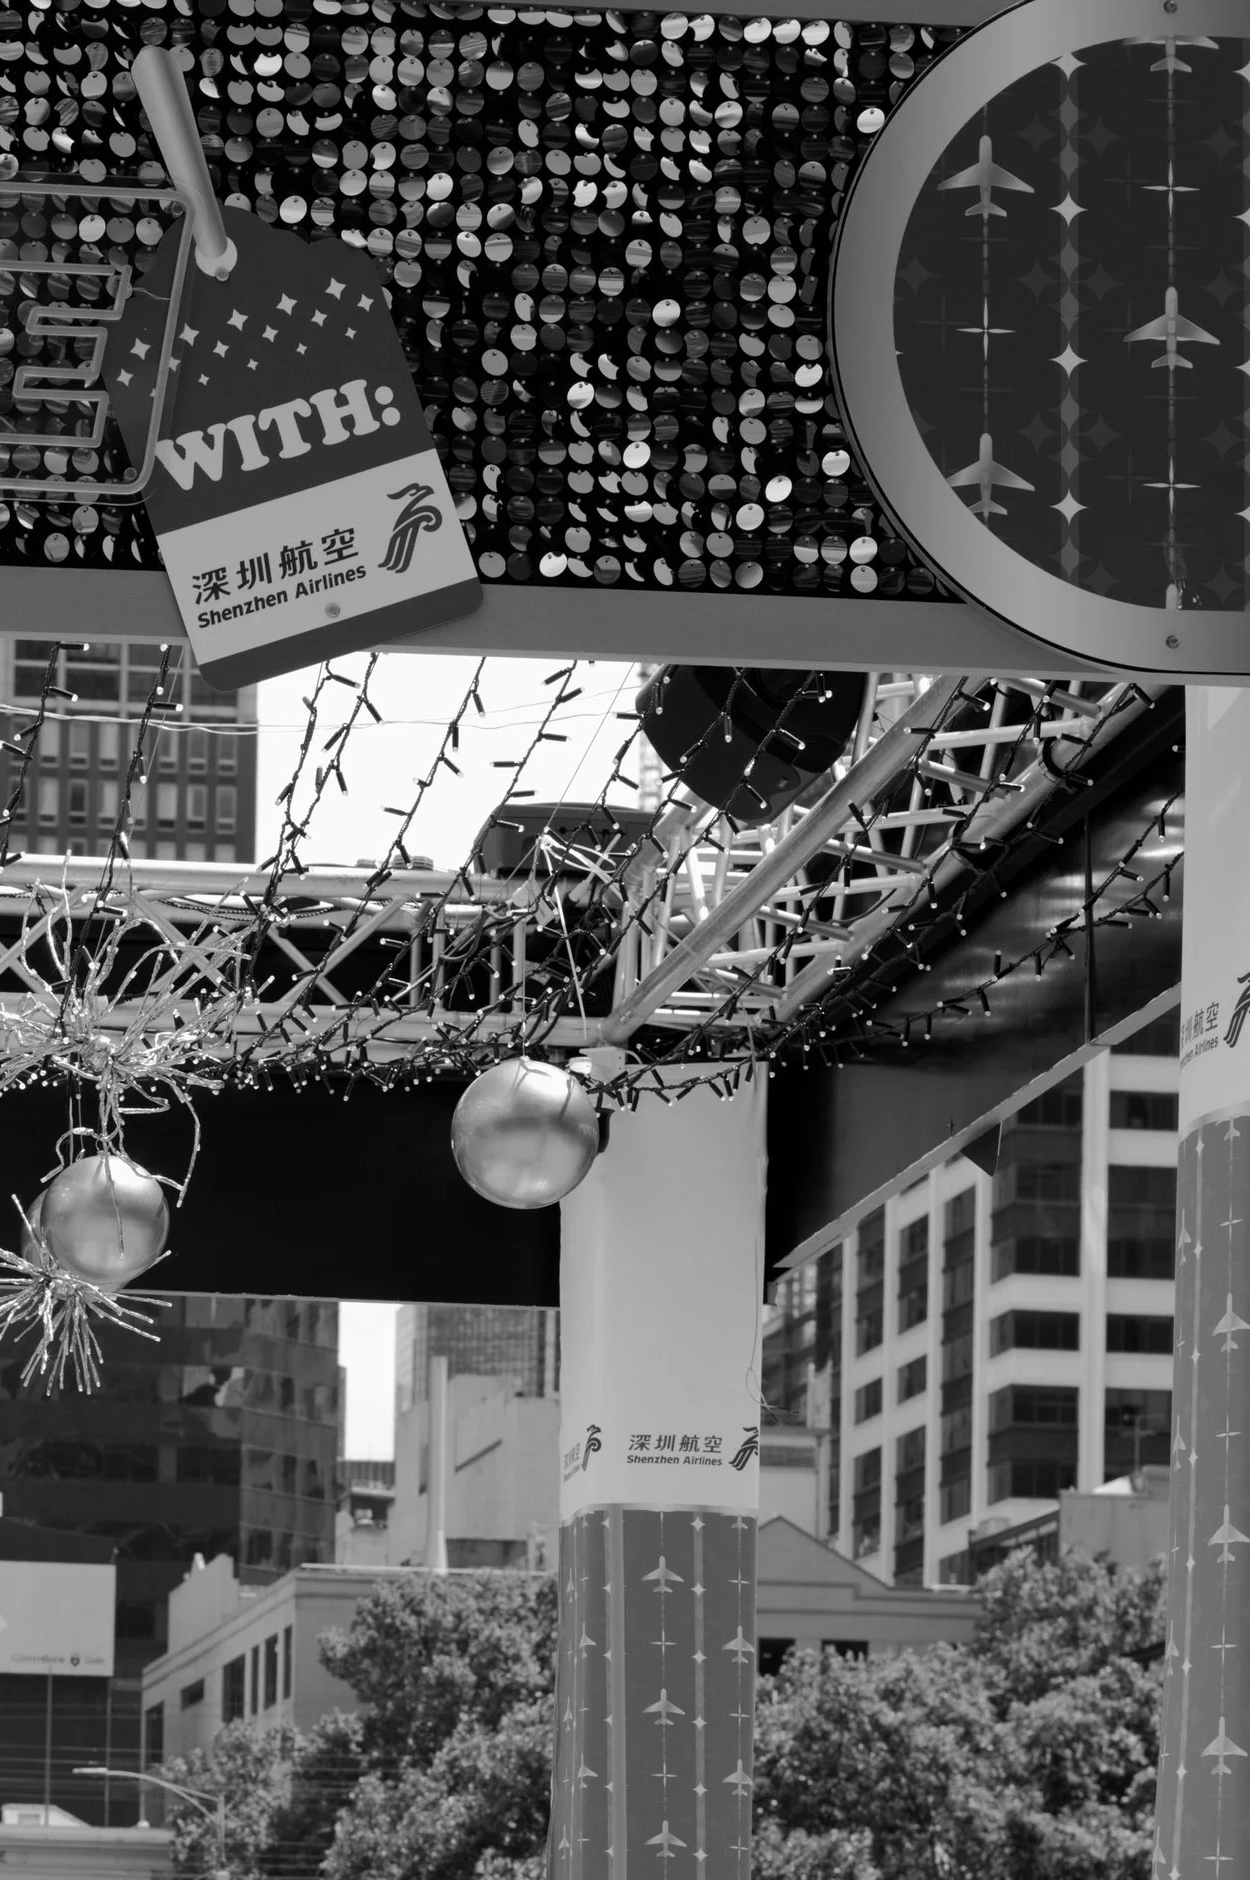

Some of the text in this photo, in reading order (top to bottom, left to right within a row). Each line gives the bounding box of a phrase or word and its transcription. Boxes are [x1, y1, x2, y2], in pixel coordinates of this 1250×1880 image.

[154, 379, 401, 491] WITH:
[192, 527, 359, 605] 深圳航空
[197, 564, 367, 628] Shenzhen Airlines
[626, 1454, 723, 1466] Shenzhen Airlines
[628, 1434, 723, 1454] 深圳航空
